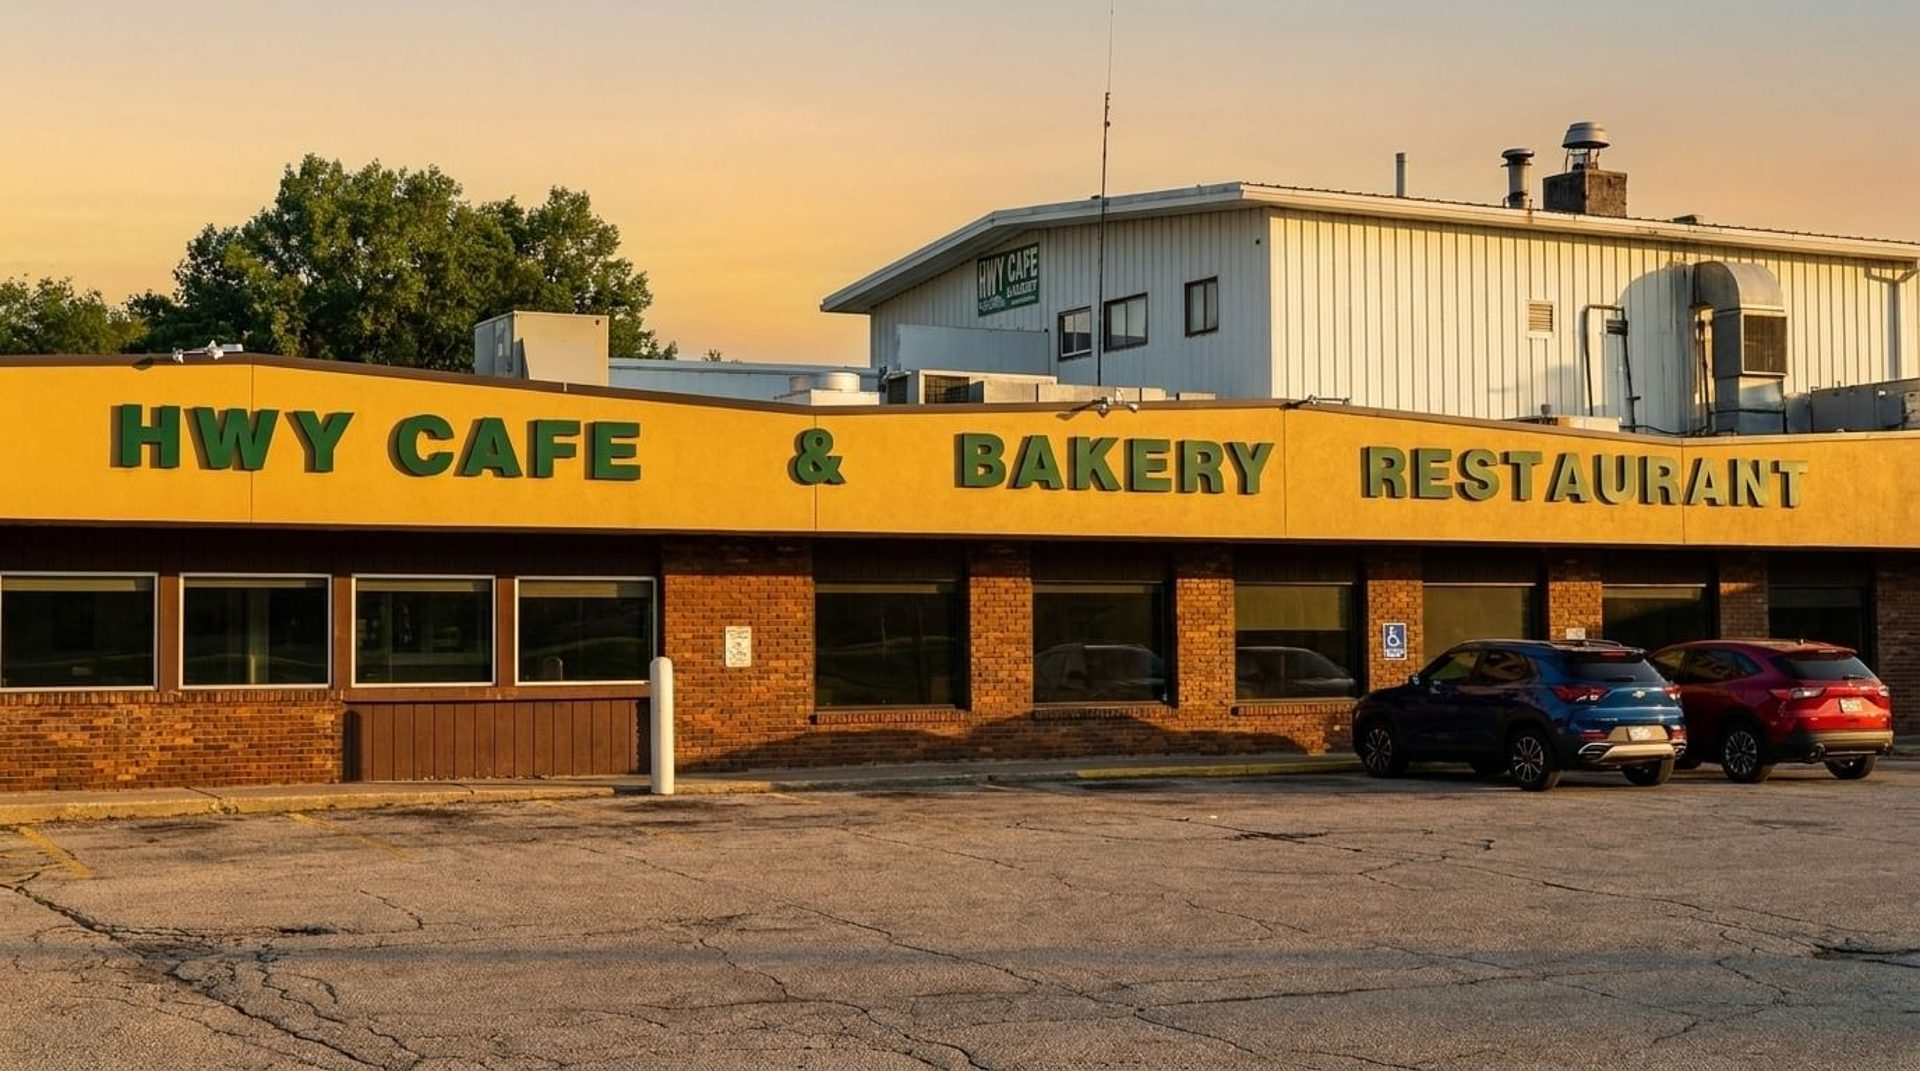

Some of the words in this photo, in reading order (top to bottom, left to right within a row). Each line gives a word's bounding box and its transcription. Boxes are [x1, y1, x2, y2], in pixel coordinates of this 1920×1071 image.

[979, 256, 1004, 298] HWY
[1008, 247, 1038, 282] CAFE
[113, 404, 353, 472] HWY
[390, 414, 641, 480] CAFE
[789, 428, 844, 485] &
[956, 433, 1274, 495] BAKERY
[1362, 446, 1808, 508] RESTAURANT
